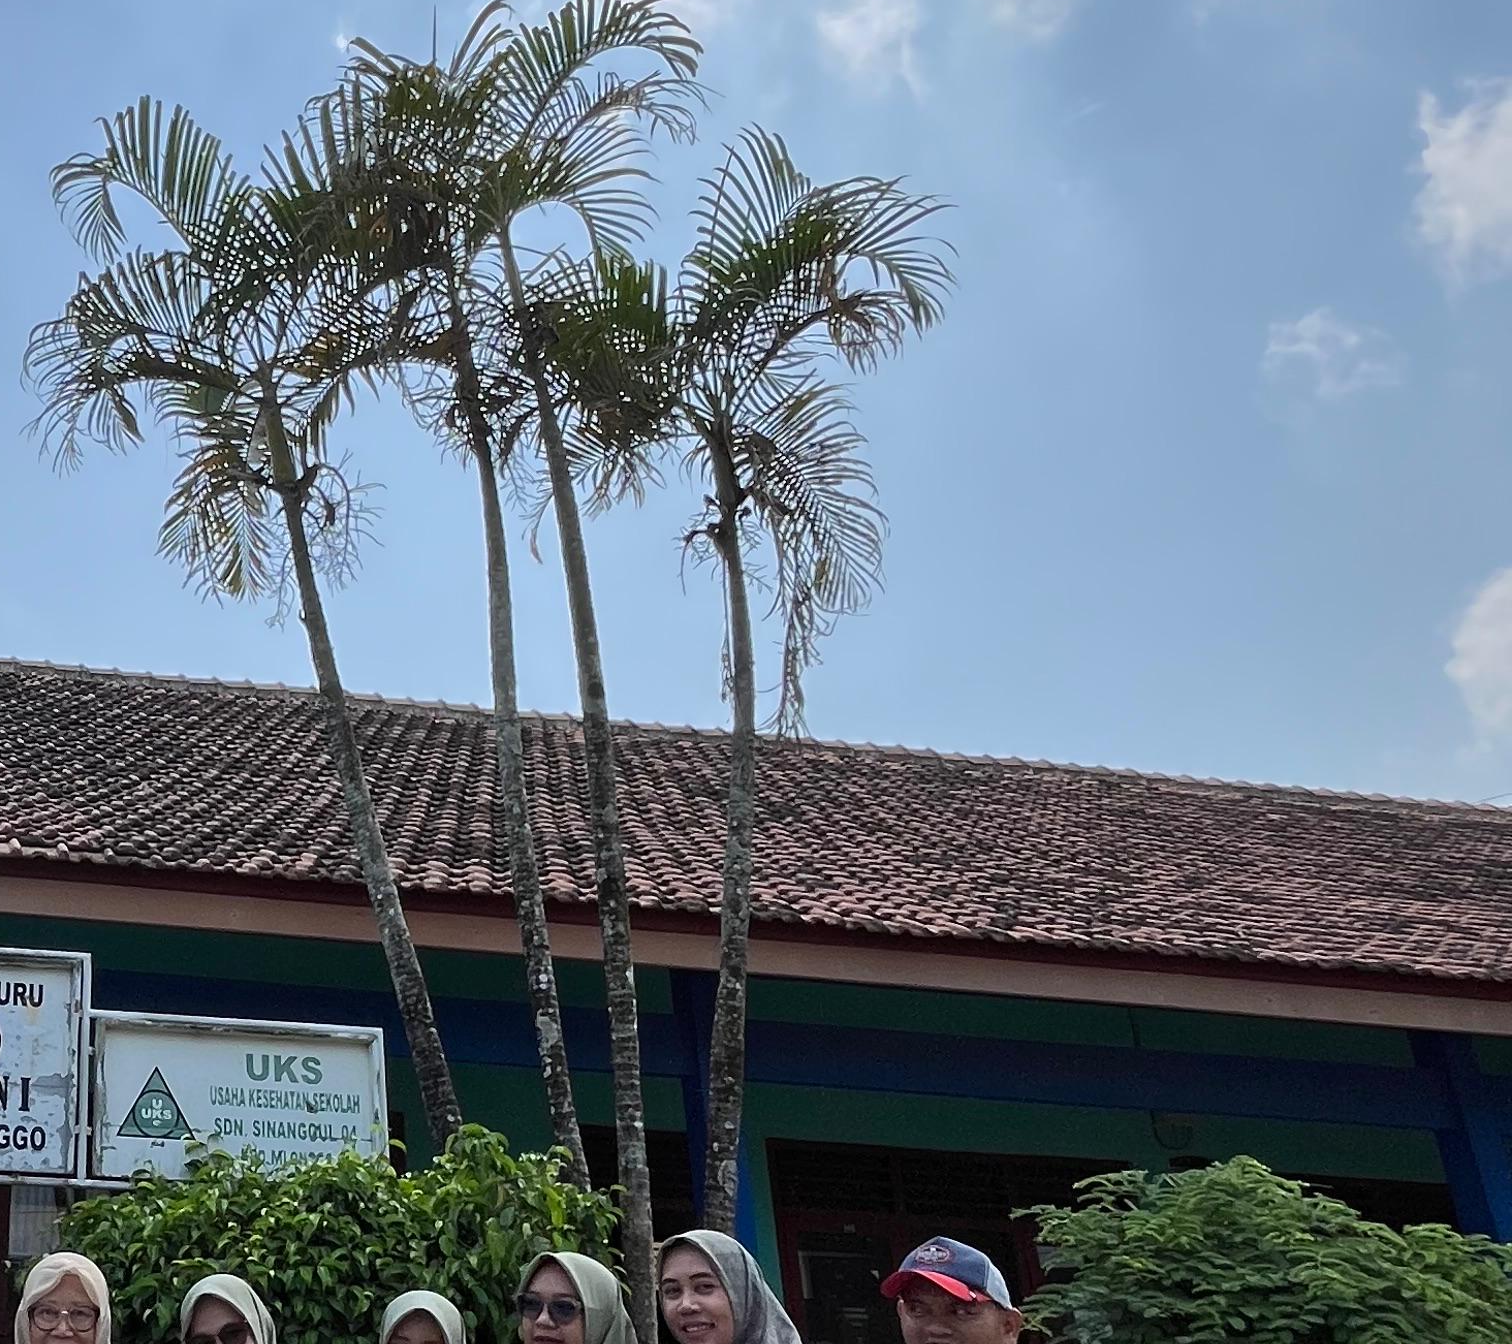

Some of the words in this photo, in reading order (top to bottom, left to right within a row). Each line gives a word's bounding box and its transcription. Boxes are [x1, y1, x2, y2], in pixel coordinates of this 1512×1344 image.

[245, 1054, 323, 1085] UKS
[19, 1076, 32, 1112] I
[209, 1084, 246, 1108] USAHA
[248, 1089, 310, 1112] KESEHATAN
[312, 1092, 361, 1115] SEKOLAH
